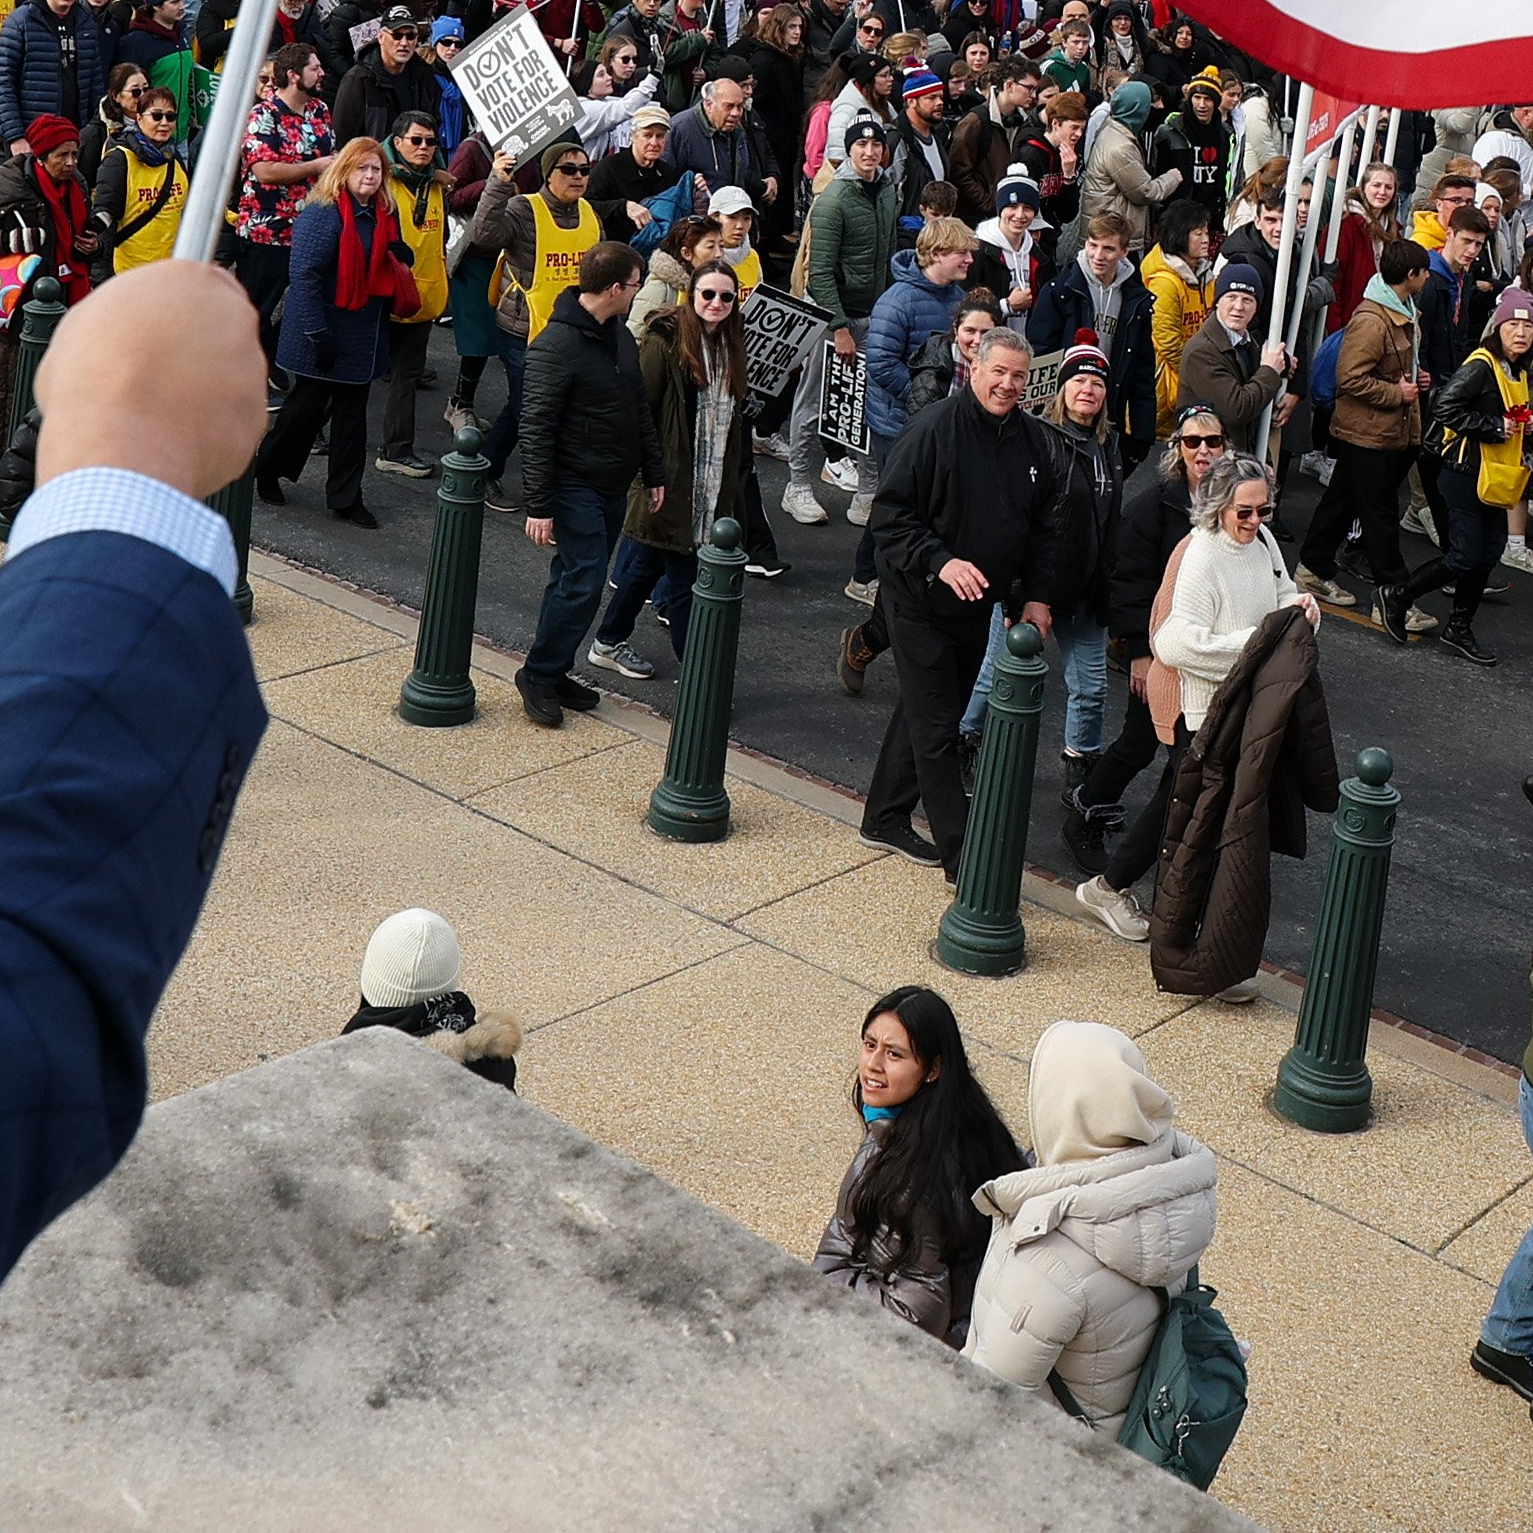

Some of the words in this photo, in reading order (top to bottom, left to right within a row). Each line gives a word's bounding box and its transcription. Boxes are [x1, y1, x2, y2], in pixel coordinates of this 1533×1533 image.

[463, 23, 530, 92] DON'T
[476, 70, 518, 112] VOTE
[512, 49, 546, 85] FOR
[487, 69, 559, 135] VIOLENCE
[1193, 146, 1201, 164] I
[744, 298, 818, 346] DON'T
[767, 341, 799, 369] FOR
[831, 353, 842, 386] THE
[829, 392, 840, 423] AM
[837, 360, 855, 443] PRO-LIF
[1031, 382, 1057, 400] OUR
